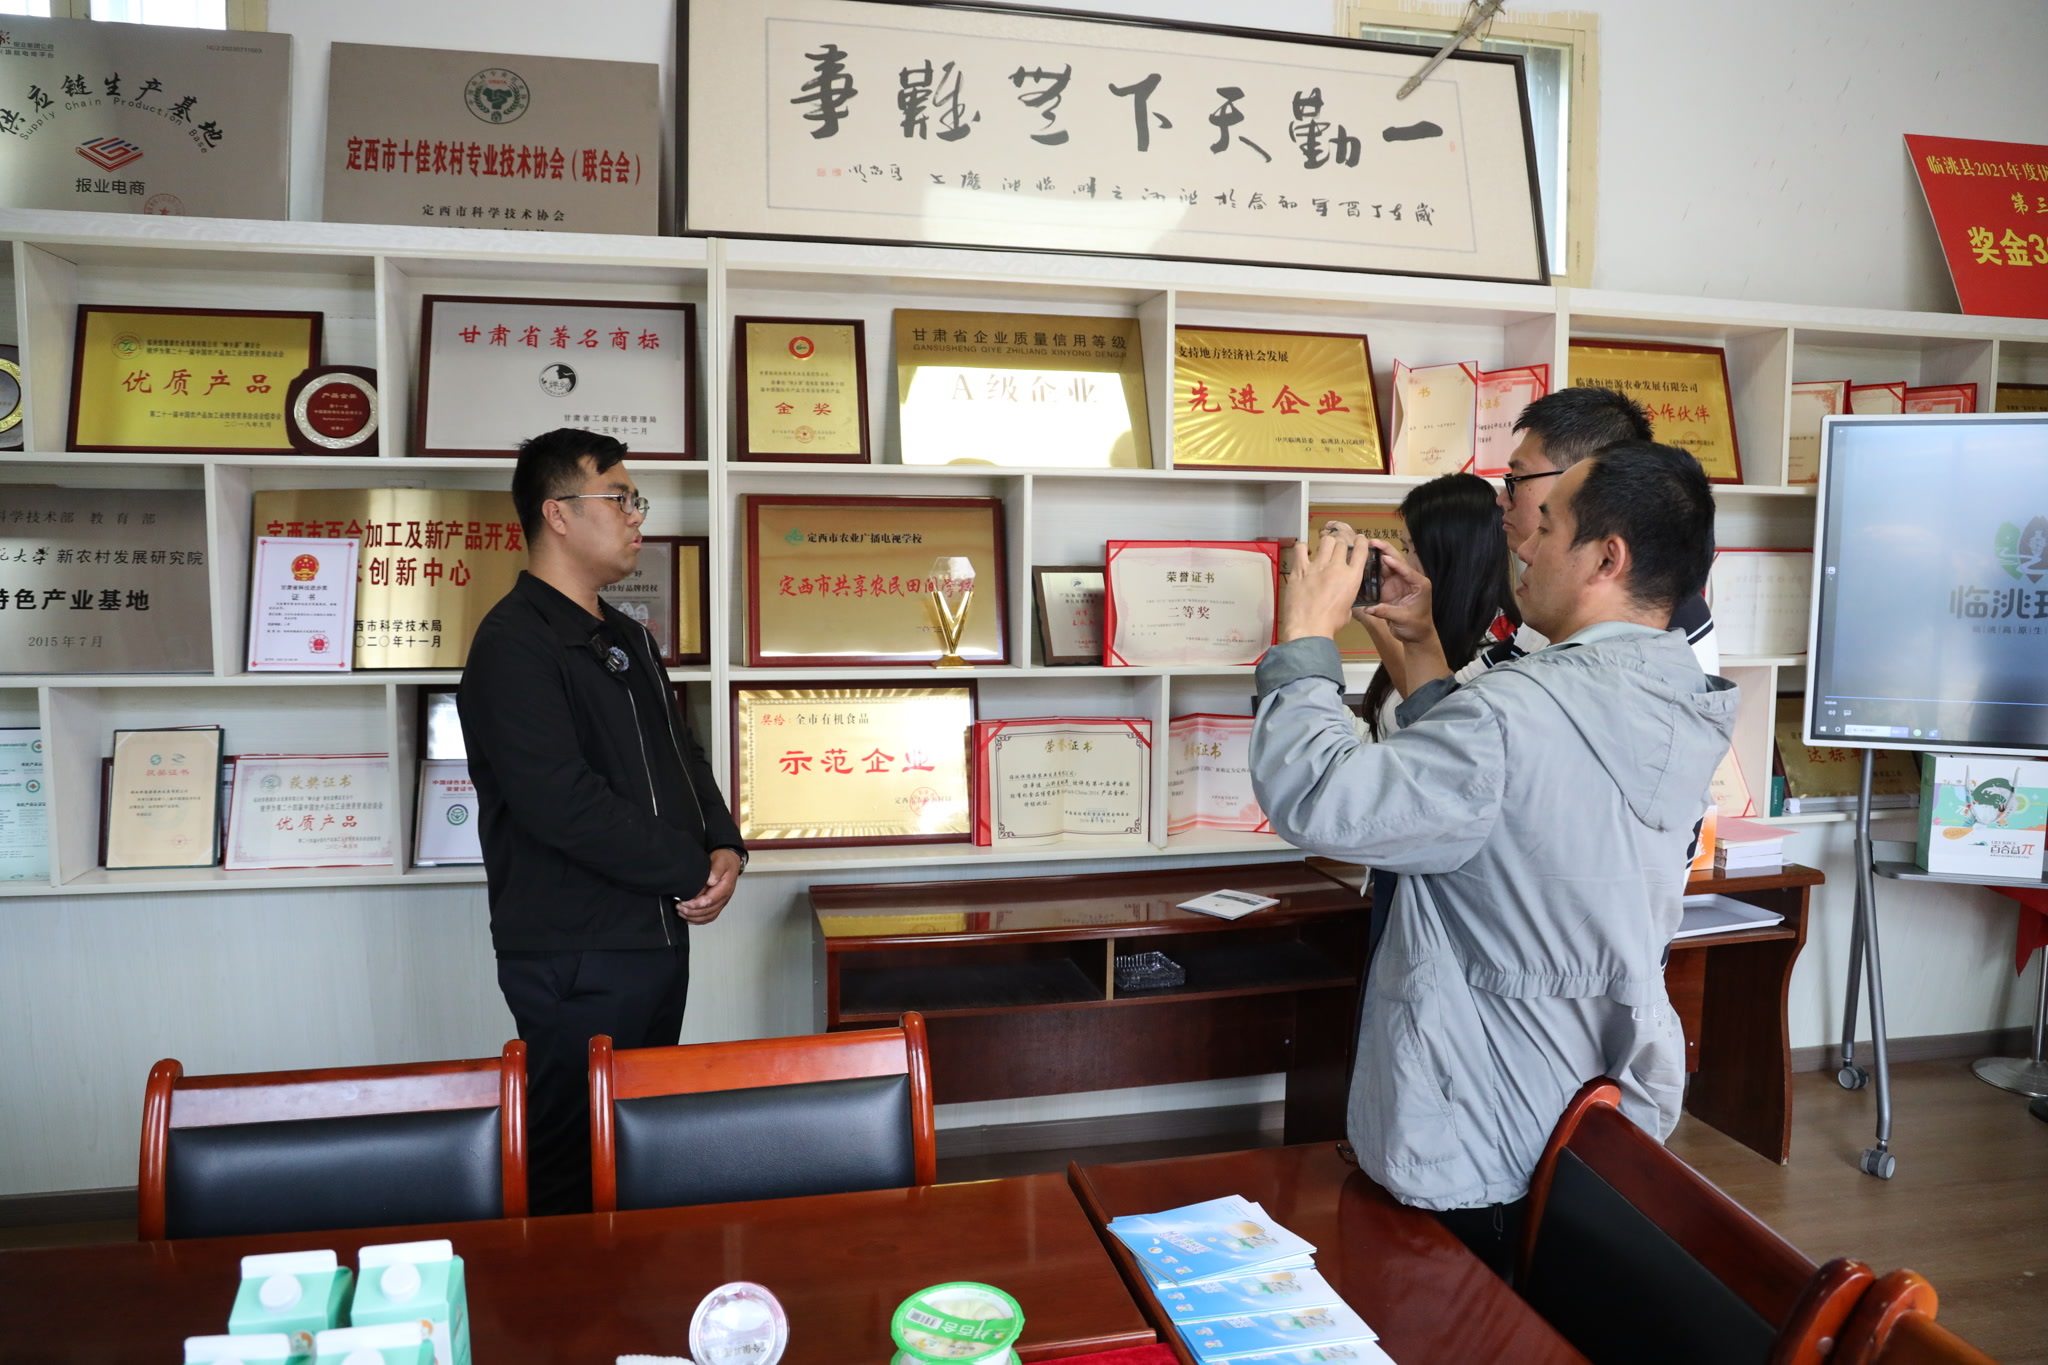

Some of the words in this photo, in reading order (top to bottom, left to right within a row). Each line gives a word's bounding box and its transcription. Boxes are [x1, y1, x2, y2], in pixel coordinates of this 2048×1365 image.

[20, 110, 56, 141] Supply
[65, 97, 102, 111] Chain
[113, 96, 182, 127] Production
[188, 128, 209, 154] Base
[75, 177, 145, 196] 报业电商
[421, 204, 566, 222] 定西市科学技术协会
[1967, 226, 2048, 267] 奖金3
[458, 323, 660, 350] 甘肃省著名商标
[912, 327, 1127, 350] 甘肃省企业质量信用等级
[913, 343, 977, 353] GANSUSHENG
[981, 346, 1002, 354] QIYE
[1006, 347, 1048, 356] ZHILIANG
[1051, 349, 1092, 358] XINYONG
[1178, 346, 1289, 363] 支持地方经济社会发展
[121, 368, 272, 396] 优质产品
[1188, 380, 1351, 415] 先进企业
[774, 401, 832, 415] 金奖
[1645, 403, 1710, 424] 合作伙伴
[564, 414, 657, 423] 甘肃省工商行政管理局
[807, 532, 922, 545] 定西市农业广播电视学校
[57, 548, 203, 565] 新农村发展研究院
[1166, 571, 1215, 584] 荣誉证书
[1168, 605, 1210, 620] 二等奖
[795, 712, 870, 726] 全市有机食品
[1045, 739, 1093, 753] 荣誉证书
[778, 747, 936, 775] 示范企业
[289, 774, 352, 790] 获奖证书
[275, 814, 357, 831] 优质产品
